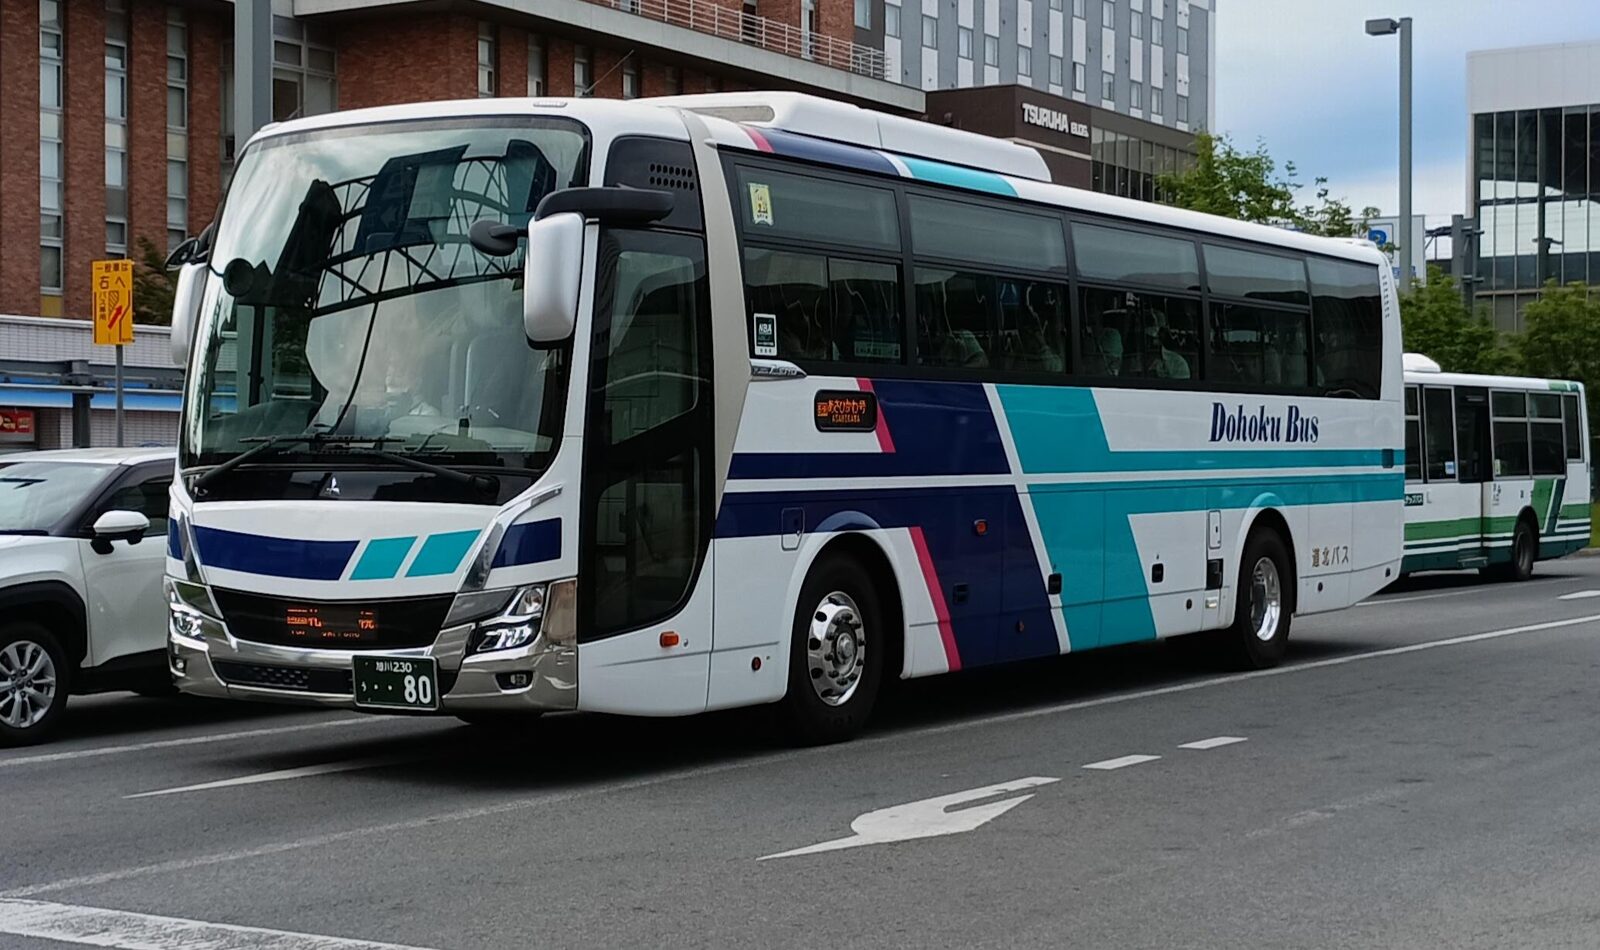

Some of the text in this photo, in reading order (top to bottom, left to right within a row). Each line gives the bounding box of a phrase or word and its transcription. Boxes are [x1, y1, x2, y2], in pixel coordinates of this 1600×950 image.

[1022, 103, 1069, 133] TSURUHA
[100, 275, 126, 289] 右へ
[1208, 402, 1319, 443] Dohoku Bus
[1311, 545, 1349, 567] 道北バス
[404, 675, 432, 704] 80
